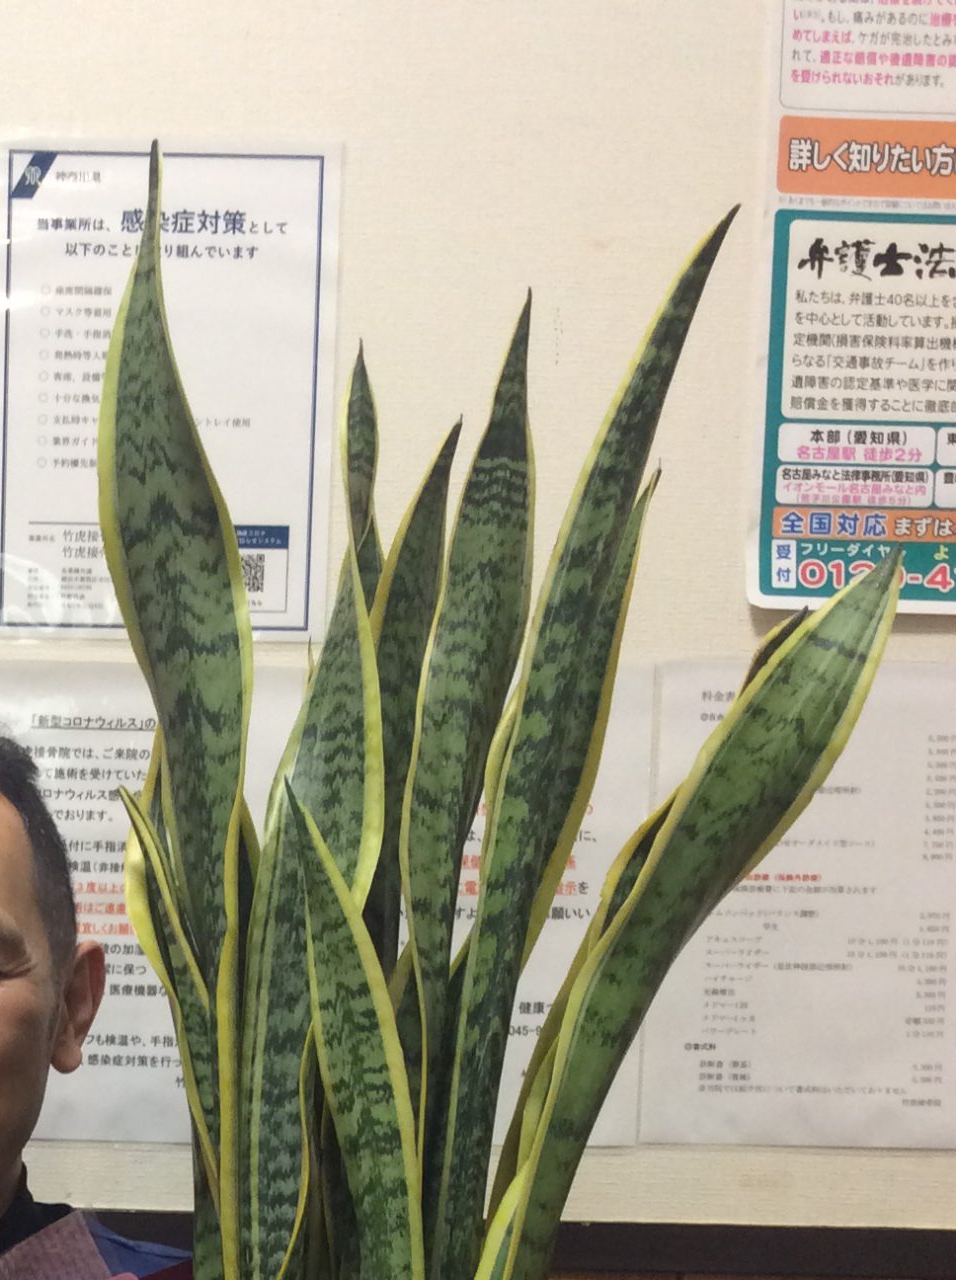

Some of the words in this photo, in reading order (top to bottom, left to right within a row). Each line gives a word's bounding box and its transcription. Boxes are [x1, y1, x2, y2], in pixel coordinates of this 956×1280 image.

[64, 242, 259, 260] 以下のことり組んでいます
[781, 512, 887, 536] 全国対応
[62, 529, 104, 543] 竹虎接
[62, 546, 105, 559] 竹虎接
[801, 543, 906, 557] フリーダイヤ
[519, 1001, 553, 1015] 健康
